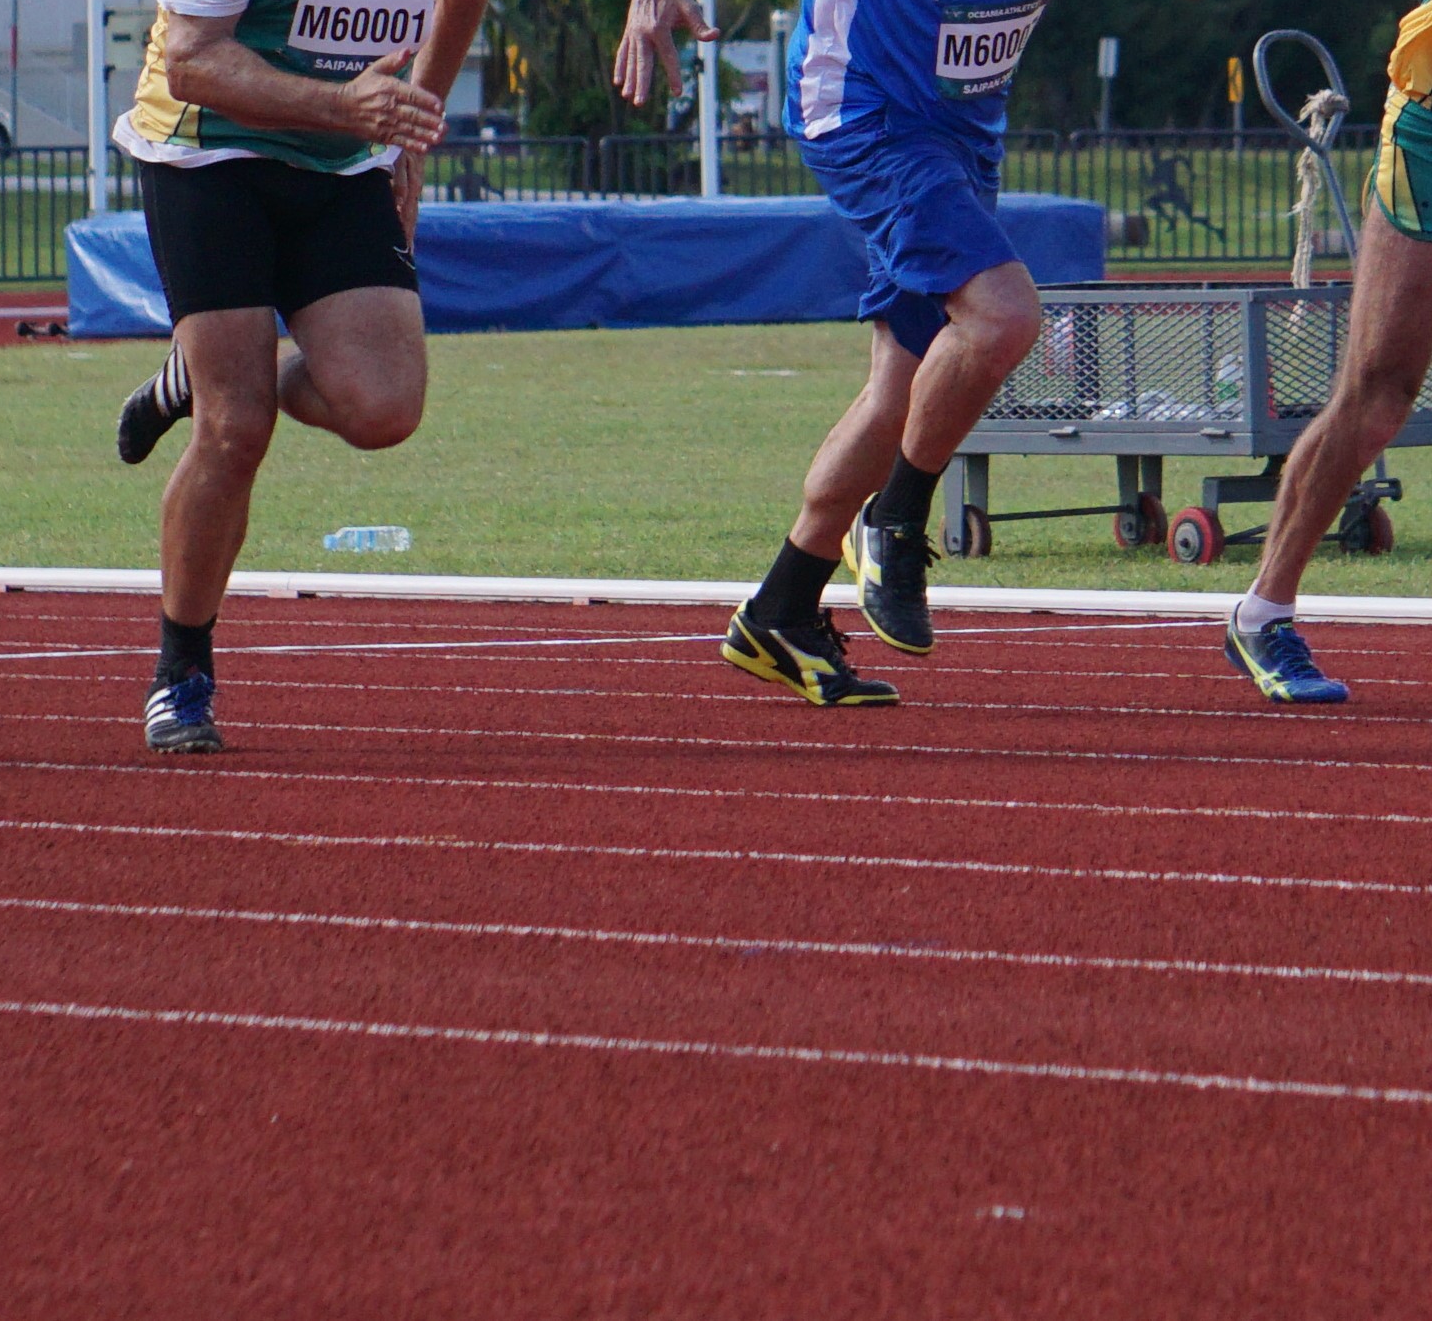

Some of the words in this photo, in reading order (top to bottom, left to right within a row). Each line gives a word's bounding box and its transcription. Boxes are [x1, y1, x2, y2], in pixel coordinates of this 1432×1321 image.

[297, 4, 425, 44] M60001
[314, 58, 365, 71] SAIPAN
[962, 79, 1001, 94] SAIPAN
